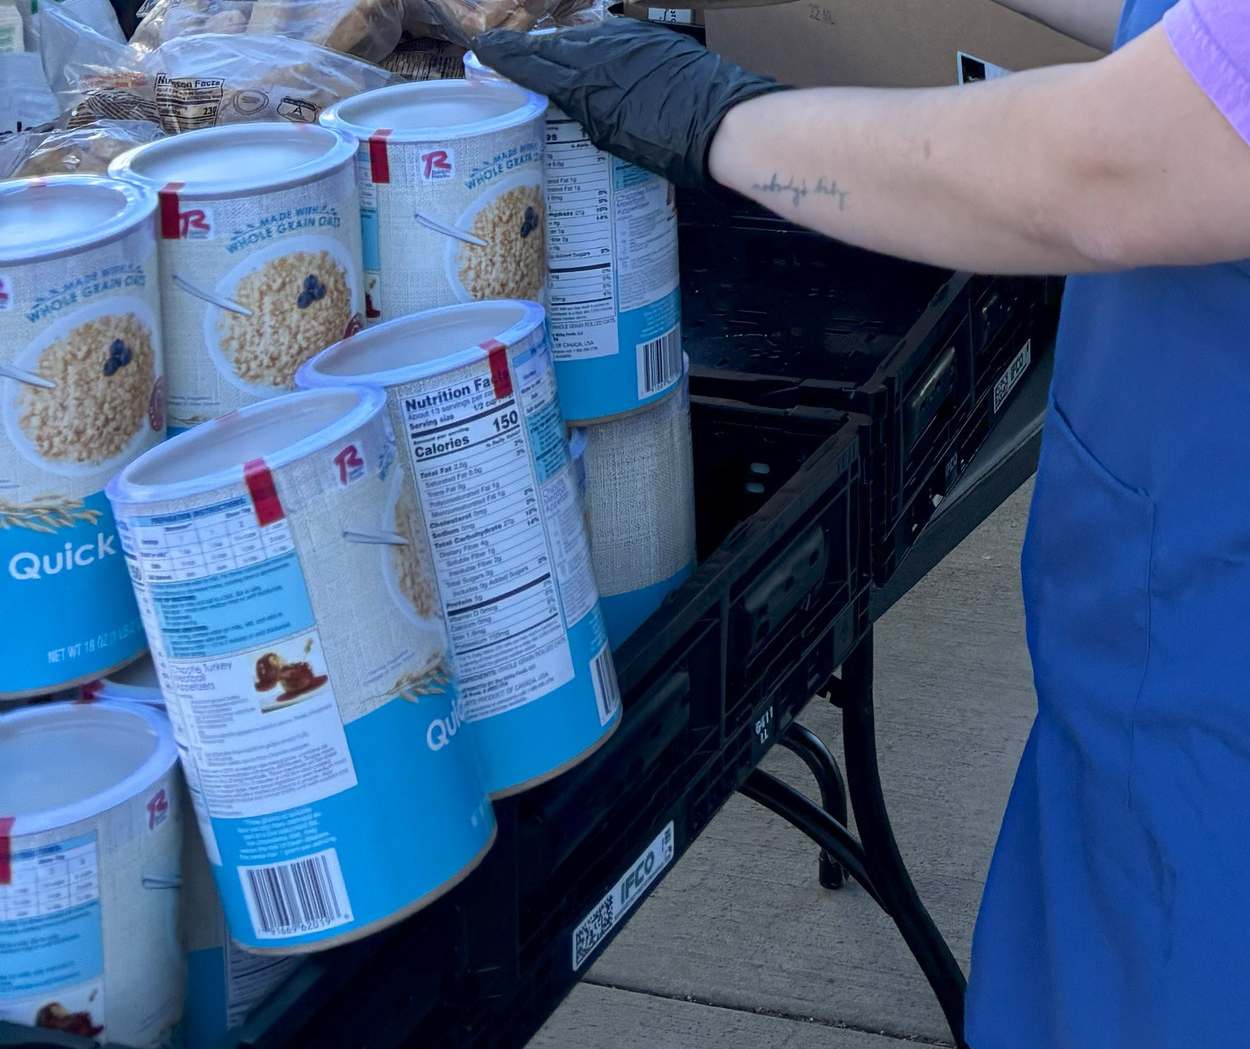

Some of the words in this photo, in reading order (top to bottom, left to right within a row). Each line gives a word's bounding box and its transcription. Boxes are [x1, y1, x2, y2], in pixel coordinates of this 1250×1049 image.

[195, 79, 220, 88] Facts
[464, 164, 503, 190] WHOLE
[506, 154, 532, 169] GRAIN
[260, 212, 291, 227] MADE
[225, 228, 274, 254] WHOLE
[278, 218, 315, 234] GRAIN
[64, 271, 98, 290] MADE
[26, 292, 78, 323] WHOLE
[82, 277, 122, 298] GRAIN
[405, 386, 471, 412] Nutrition
[408, 411, 429, 421] About
[431, 408, 440, 416] 13
[441, 399, 471, 415] servings
[471, 394, 483, 404] per
[409, 418, 438, 431] Serving
[440, 414, 455, 423] size
[473, 403, 484, 411] 1/2
[413, 436, 436, 446] Amount
[415, 435, 470, 458] Calories
[492, 410, 519, 432] 150
[420, 470, 438, 479] Total
[425, 476, 456, 488] Saturated
[456, 471, 468, 480] Fat
[480, 484, 491, 492] Fat
[492, 482, 500, 490] 1g
[430, 513, 472, 529] Cholesterol
[431, 528, 460, 539] Sodium
[434, 540, 453, 549] Total
[454, 523, 502, 543] Carbohydrate
[439, 547, 462, 559] Dietary
[463, 542, 479, 551] Fiber
[527, 517, 540, 526] 14%
[8, 532, 117, 580] Quick
[446, 555, 470, 567] Soluble
[471, 550, 486, 559] Fiber
[477, 558, 493, 569] Fiber
[452, 585, 478, 597] Includes
[488, 575, 509, 586] Added
[508, 565, 529, 579] Sugars
[462, 573, 484, 584] Sugars
[446, 597, 473, 609] Protein
[48, 647, 65, 663] NET
[68, 643, 82, 657] WT
[85, 639, 96, 652] 18
[98, 635, 108, 648] OZ
[202, 662, 232, 672] Turkey
[620, 850, 655, 906] IFCO
